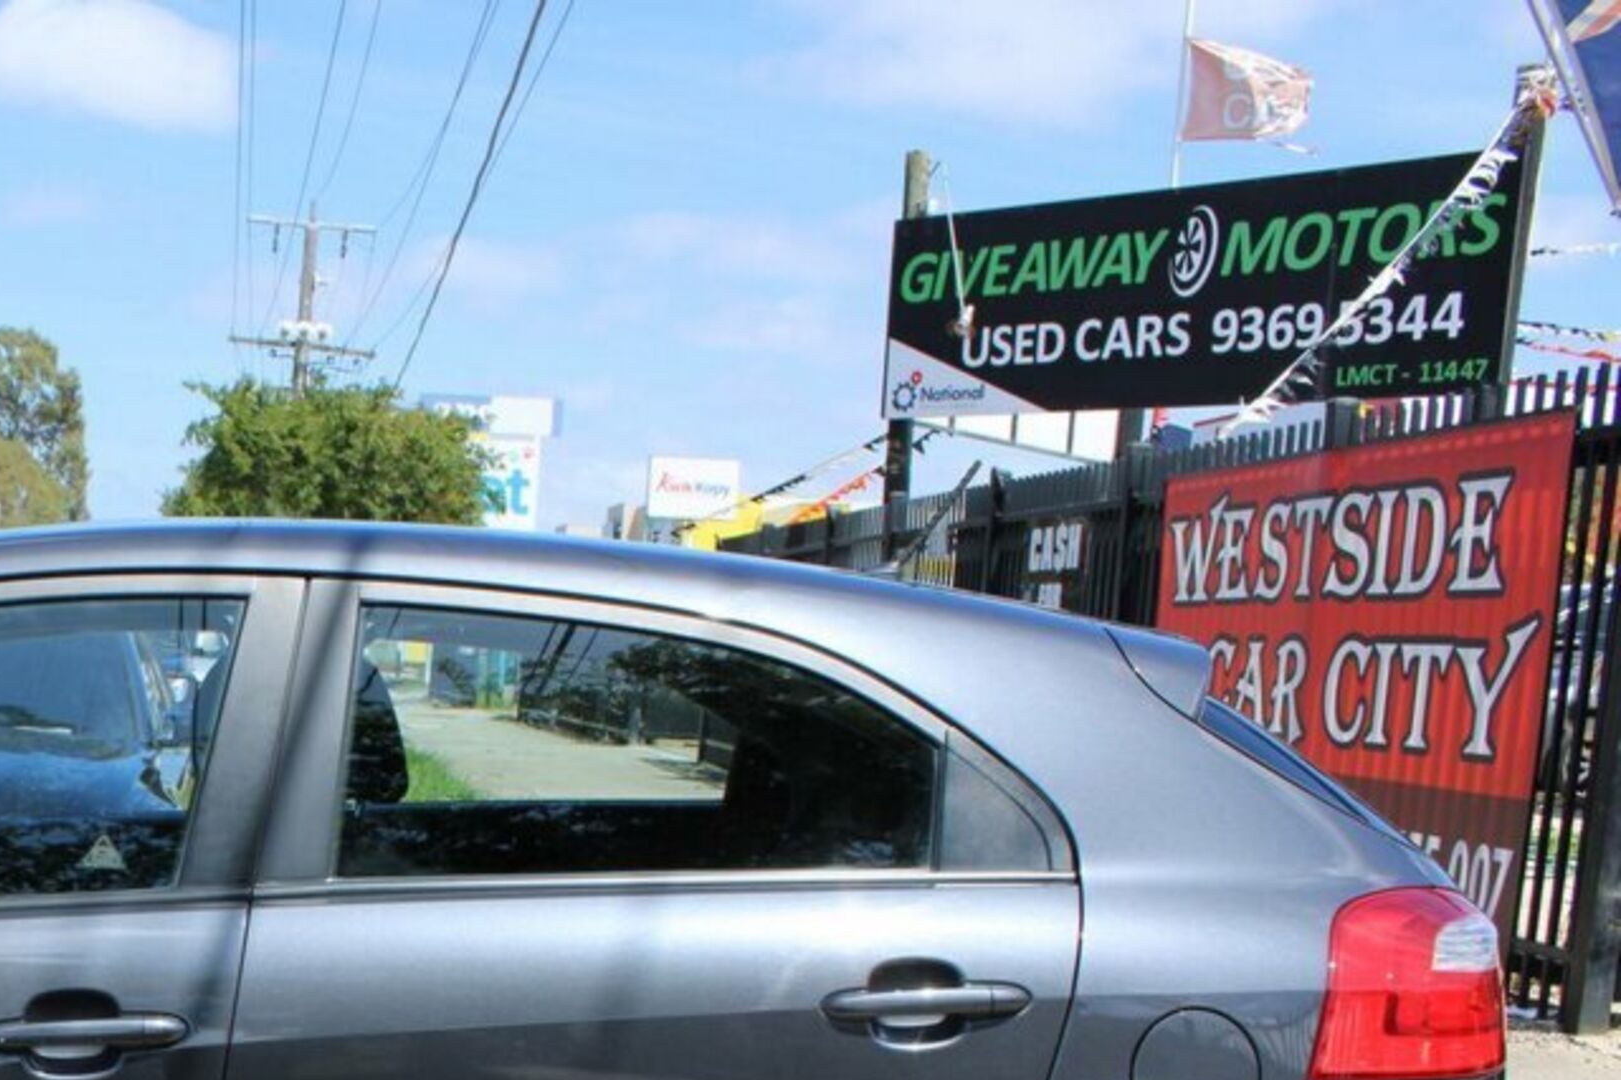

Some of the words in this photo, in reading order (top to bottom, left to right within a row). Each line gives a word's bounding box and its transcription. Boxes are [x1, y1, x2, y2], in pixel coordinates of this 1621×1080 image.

[899, 229, 1170, 304] GIVEAWAY
[1220, 193, 1507, 277] MOTORS
[961, 322, 1066, 368] USED
[1074, 312, 1192, 361] CARS
[1211, 302, 1324, 353] 9369
[1335, 291, 1465, 346] 5344
[1336, 363, 1398, 386] LMCT
[1419, 359, 1489, 382] 11447
[920, 384, 986, 401] National
[1170, 475, 1513, 603] WESTSIDE
[1209, 638, 1308, 744] CAR
[1323, 617, 1540, 756] CITY
